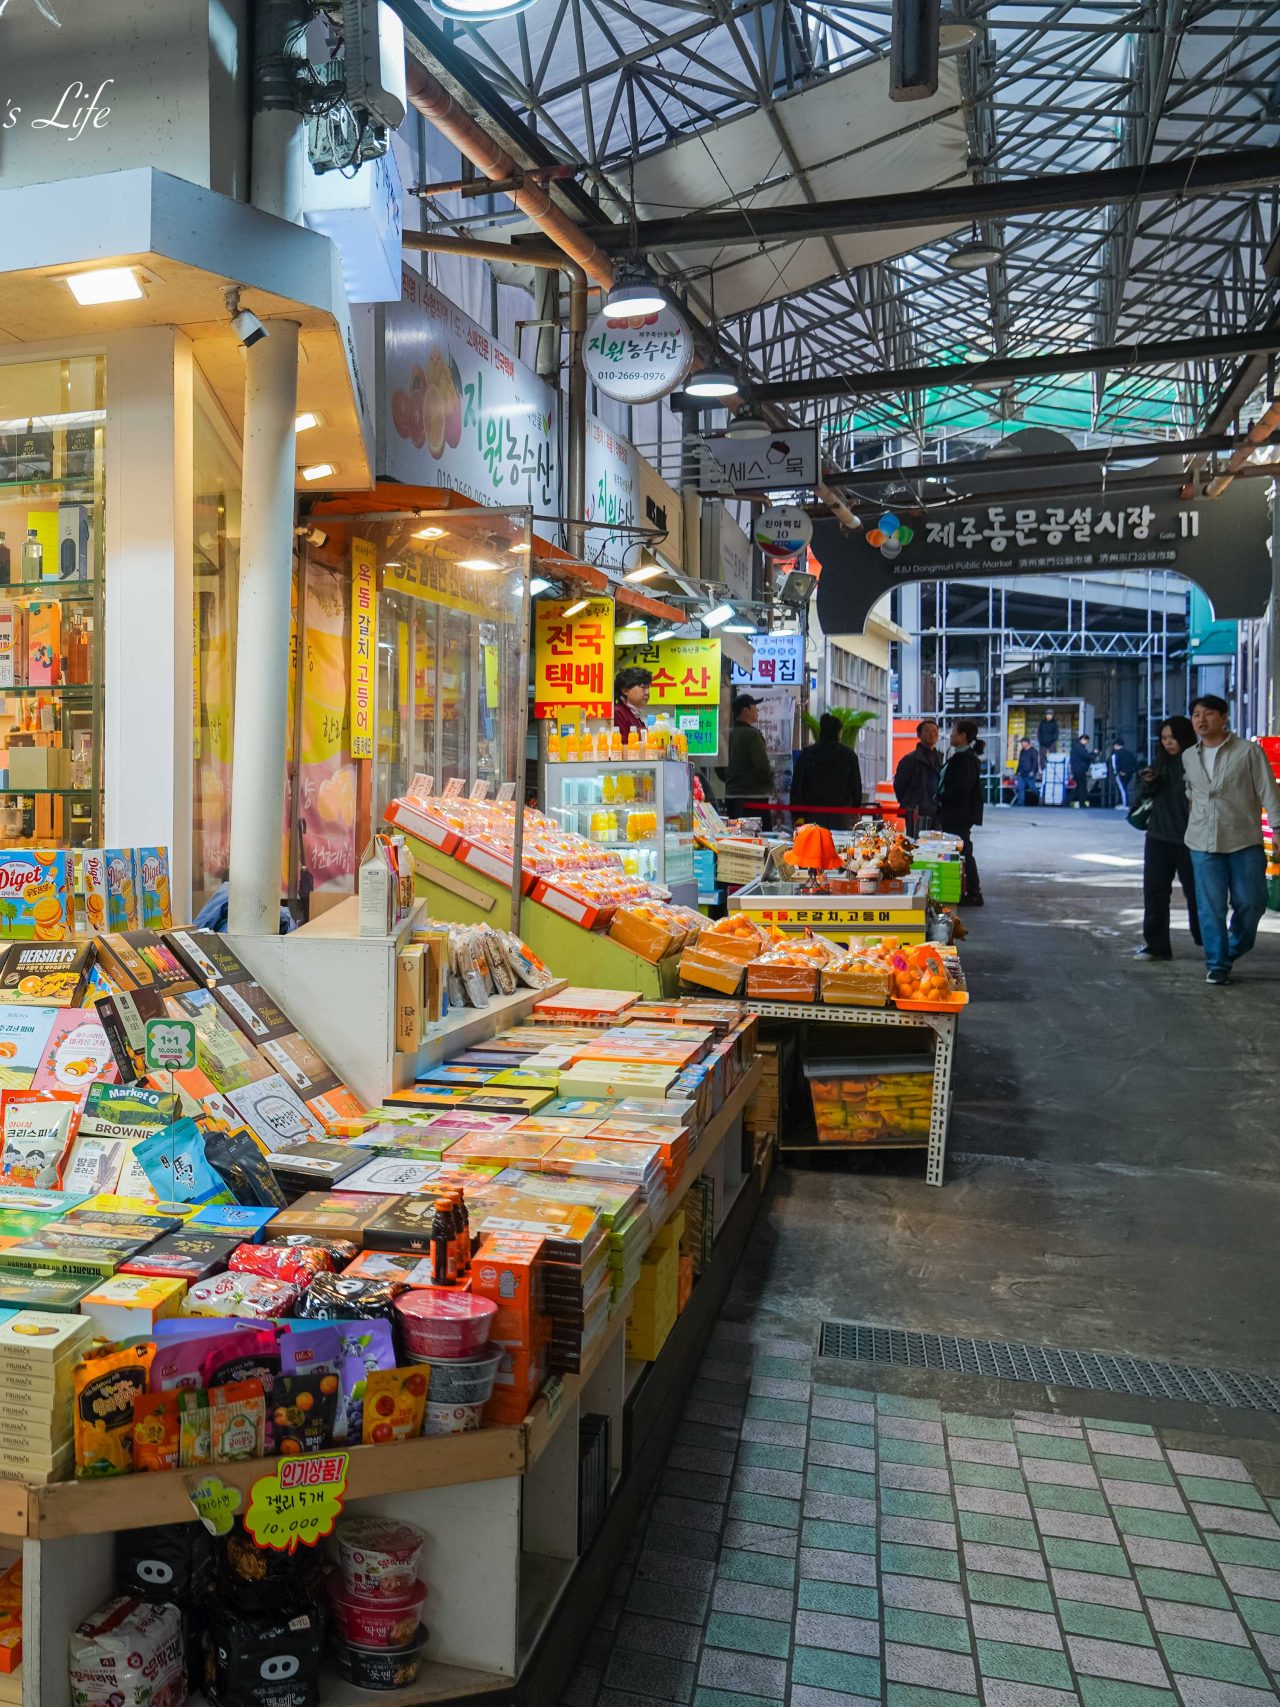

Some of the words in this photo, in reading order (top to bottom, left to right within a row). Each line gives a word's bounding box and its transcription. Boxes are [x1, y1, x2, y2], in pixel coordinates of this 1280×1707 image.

[588, 332, 682, 362] 지원농수산
[598, 371, 666, 381] 010-2669-0976
[463, 371, 554, 506] 지원농수산
[785, 457, 804, 478] 묵
[765, 519, 802, 529] 진아떡집
[776, 530, 789, 539] 10
[925, 504, 1156, 552] 제주동문공설시장
[1178, 511, 1200, 537] 11
[892, 564, 912, 574] JEJU
[912, 562, 954, 574] Dongmun
[955, 560, 981, 571] Public
[982, 559, 1012, 569] Market
[357, 613, 370, 660] 갈치
[545, 623, 606, 656] 전국
[544, 662, 604, 694] 택배
[730, 659, 796, 682] 아떡집
[356, 664, 369, 732] 고등어
[19, 947, 77, 964] HERSHEY'S
[160, 1035, 179, 1045] 1+1
[109, 1087, 149, 1101] Market
[148, 1094, 159, 1104] O
[95, 1123, 153, 1140] BROWNIE
[281, 1457, 346, 1489] 인기상품!
[265, 1494, 295, 1514] 젤리
[298, 1490, 325, 1507] 5개
